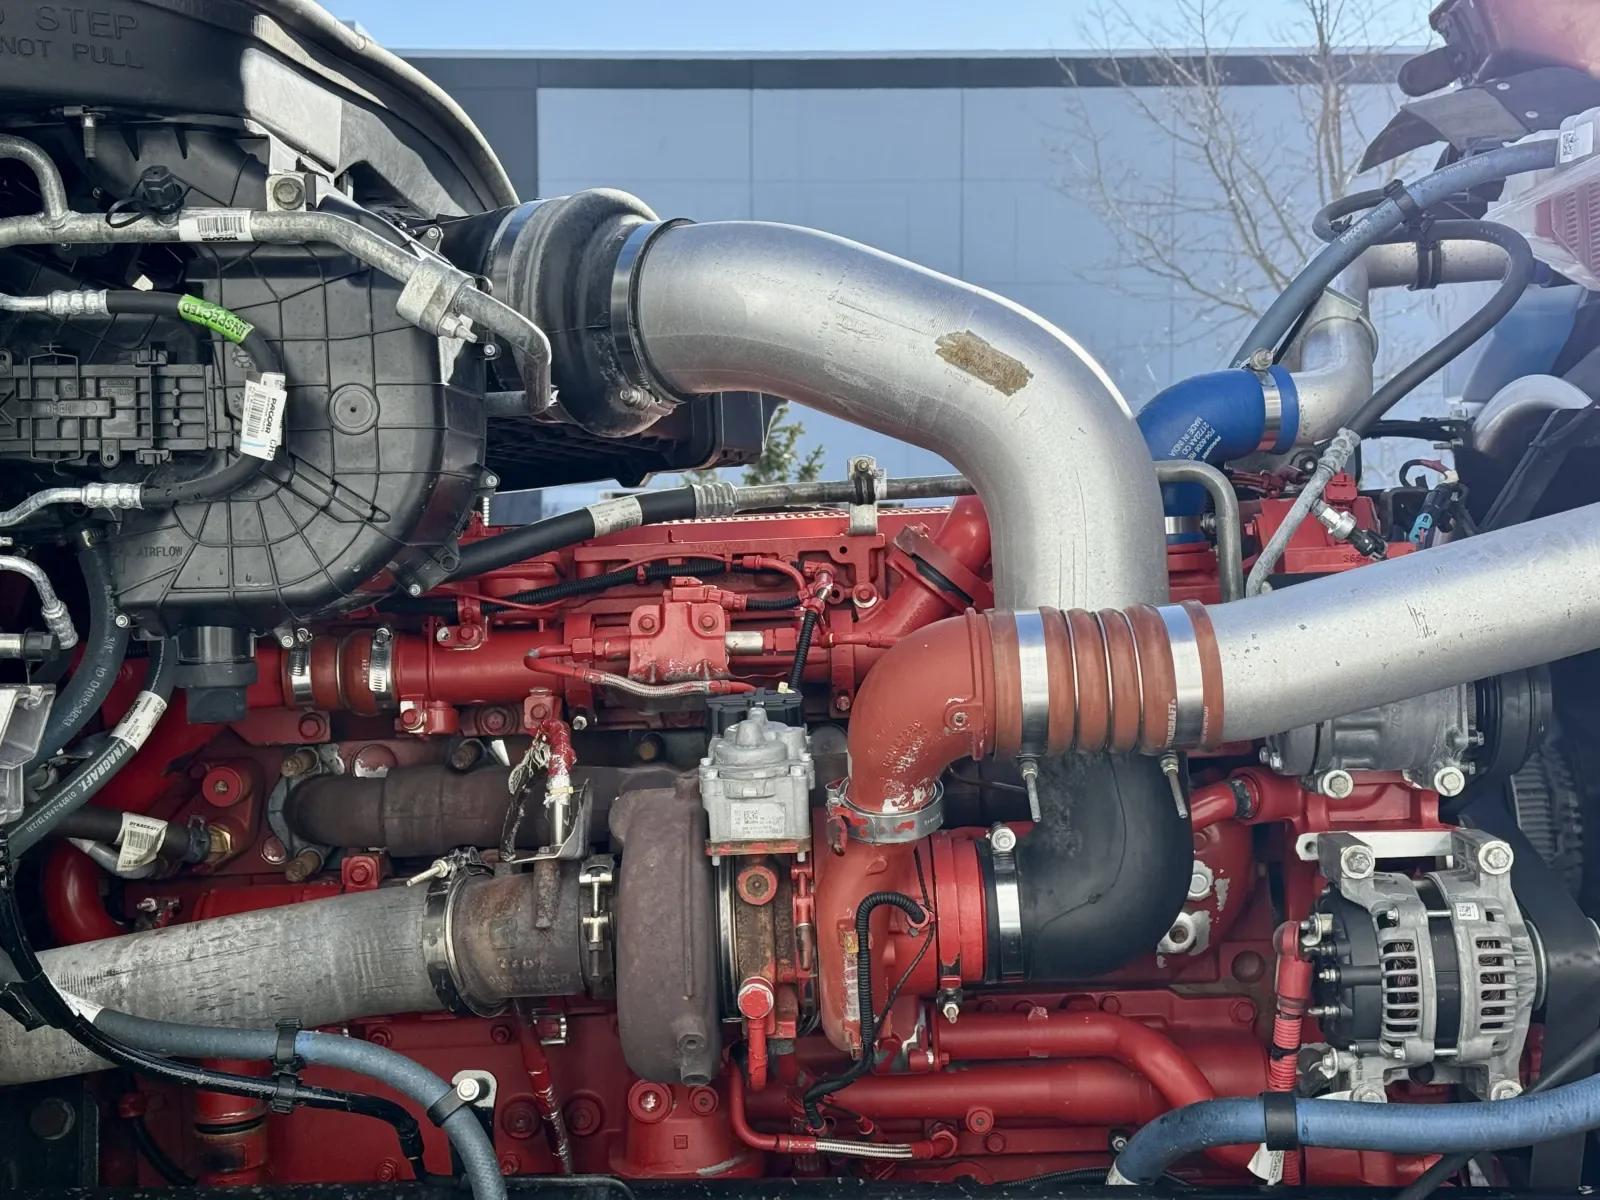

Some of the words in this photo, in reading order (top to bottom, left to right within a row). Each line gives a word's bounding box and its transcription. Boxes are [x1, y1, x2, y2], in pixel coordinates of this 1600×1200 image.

[35, 6, 138, 40] STEP
[72, 42, 144, 69] PULL
[182, 302, 247, 337] INSPECTED
[264, 397, 278, 434] PACCAR
[1188, 415, 1203, 434] MADE
[1168, 439, 1185, 457] INDIA
[136, 546, 183, 557] AIRFLOW
